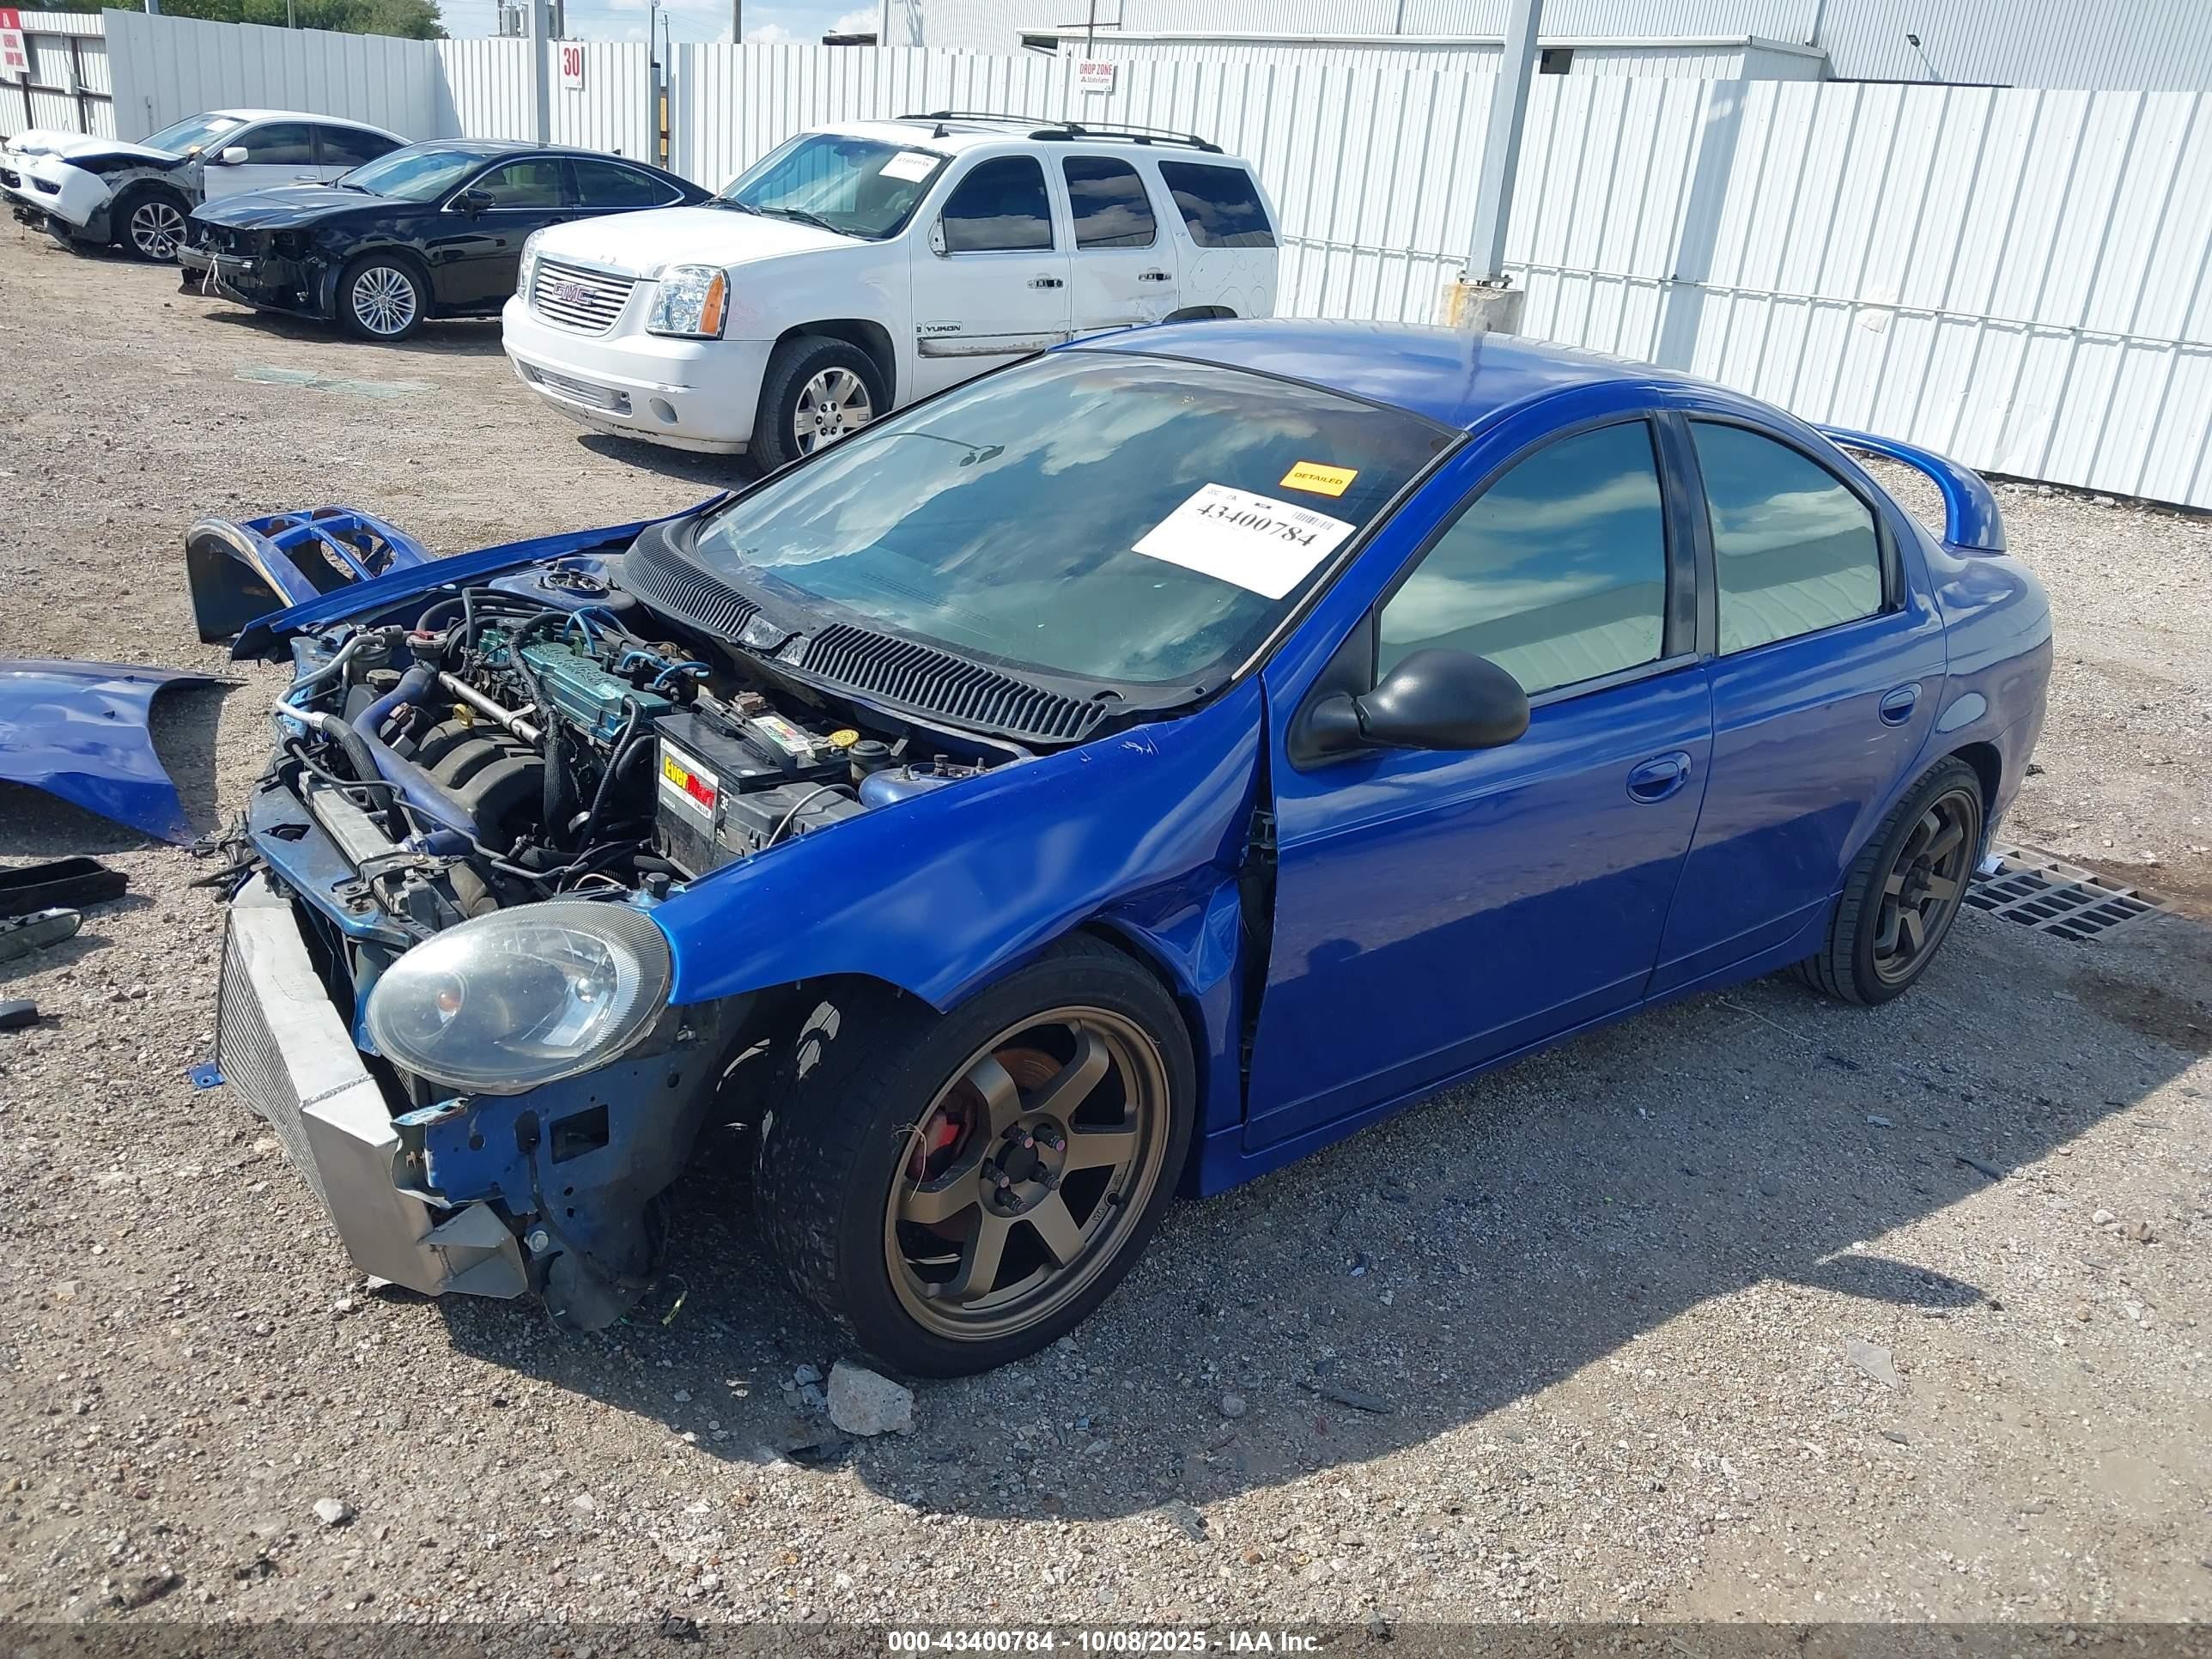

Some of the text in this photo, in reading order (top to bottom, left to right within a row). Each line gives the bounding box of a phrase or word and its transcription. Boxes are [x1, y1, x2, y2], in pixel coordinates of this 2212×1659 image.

[563, 47, 580, 76] 30
[1079, 63, 1113, 76] DROP ZONE
[553, 282, 596, 306] GMC
[1293, 471, 1344, 486] DETAILED
[1196, 502, 1318, 547] 43400784
